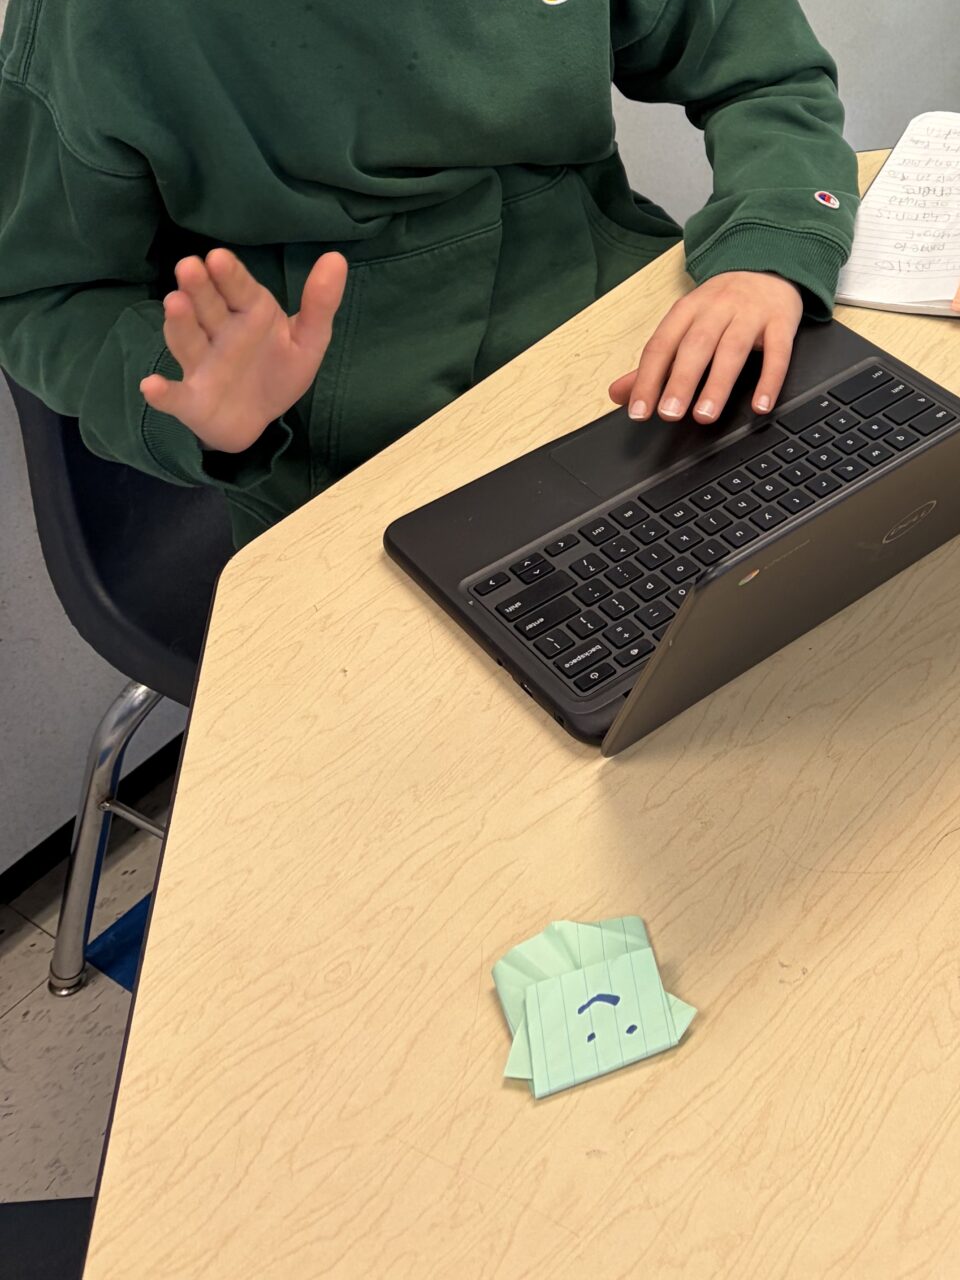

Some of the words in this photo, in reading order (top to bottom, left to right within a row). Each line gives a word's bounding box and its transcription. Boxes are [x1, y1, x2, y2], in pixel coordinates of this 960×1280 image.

[890, 384, 905, 395] shift
[623, 510, 634, 519] alt
[592, 526, 604, 536] ctrl
[504, 600, 522, 615] shift
[525, 617, 544, 632] enter
[564, 644, 602, 669] backspace
